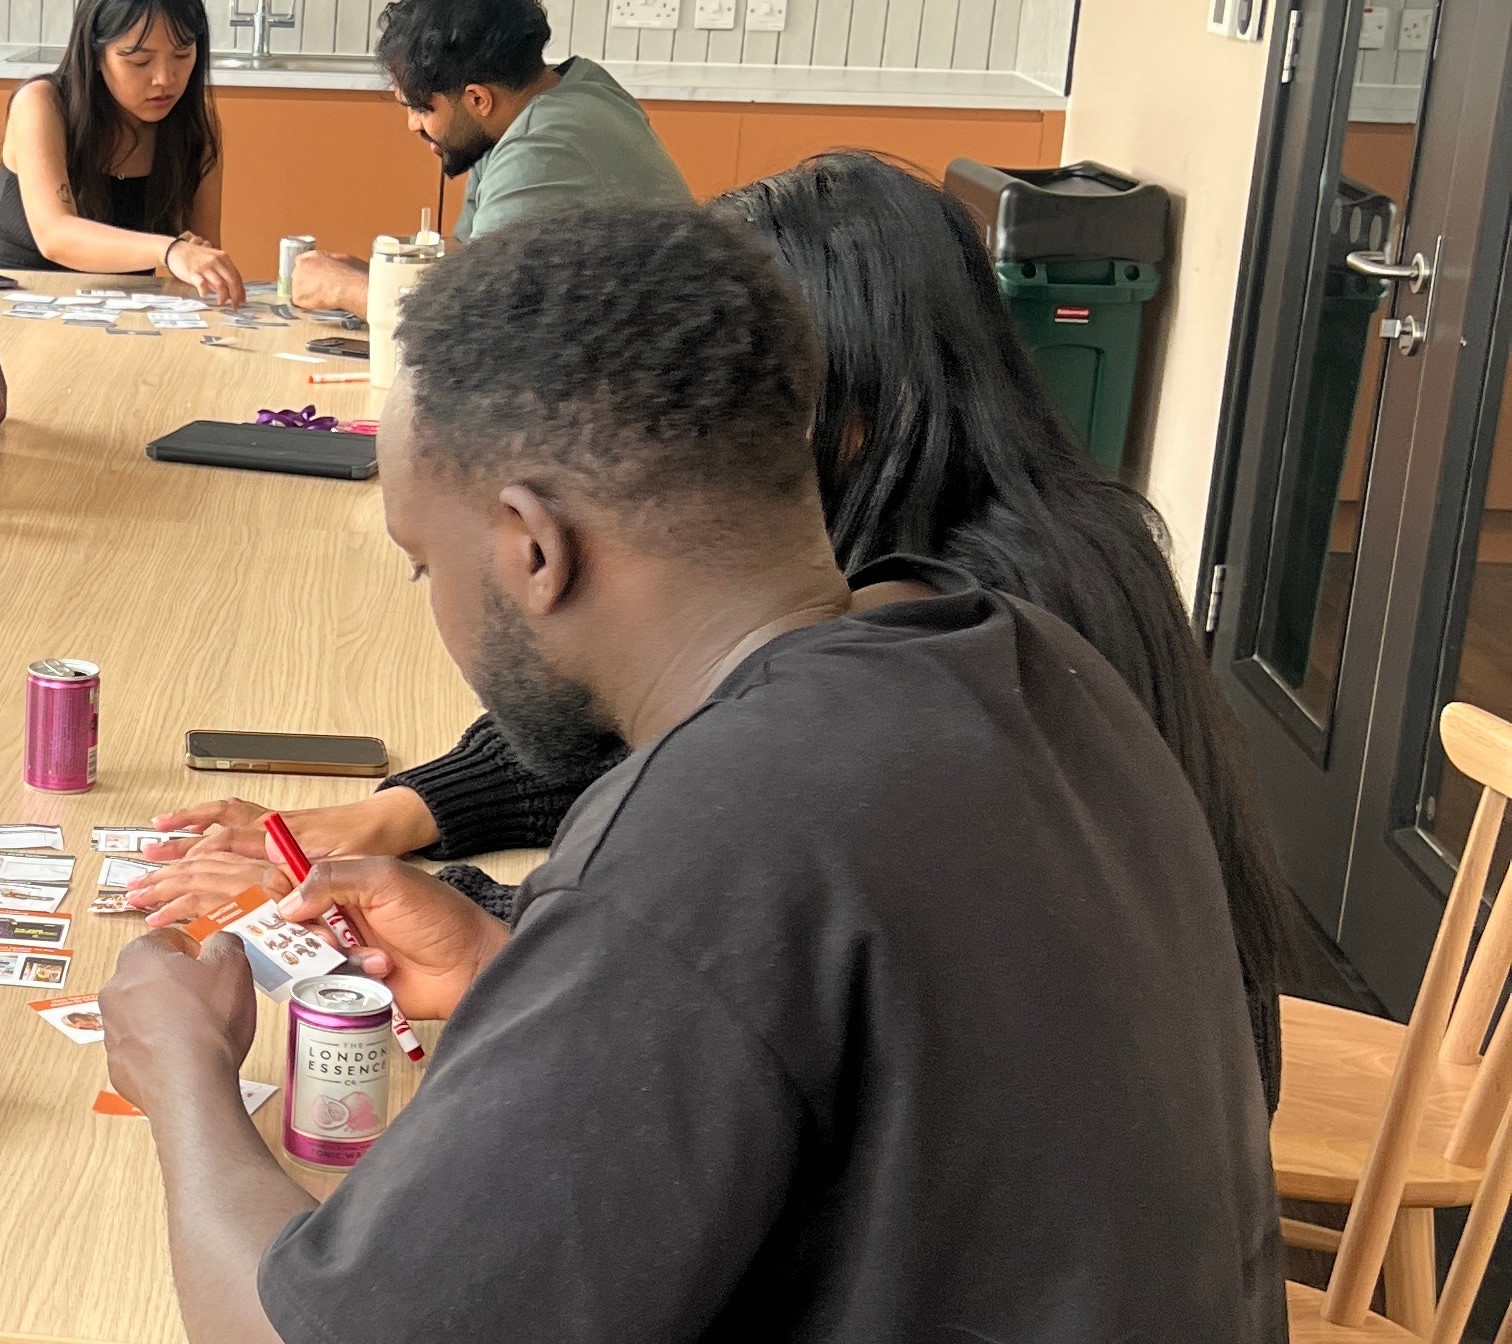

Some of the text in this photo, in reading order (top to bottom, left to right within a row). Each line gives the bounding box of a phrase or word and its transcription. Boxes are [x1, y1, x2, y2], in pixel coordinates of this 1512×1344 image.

[309, 1046, 388, 1063] LONDON
[343, 1042, 364, 1050] THE
[308, 1059, 387, 1076] ESSENCE
